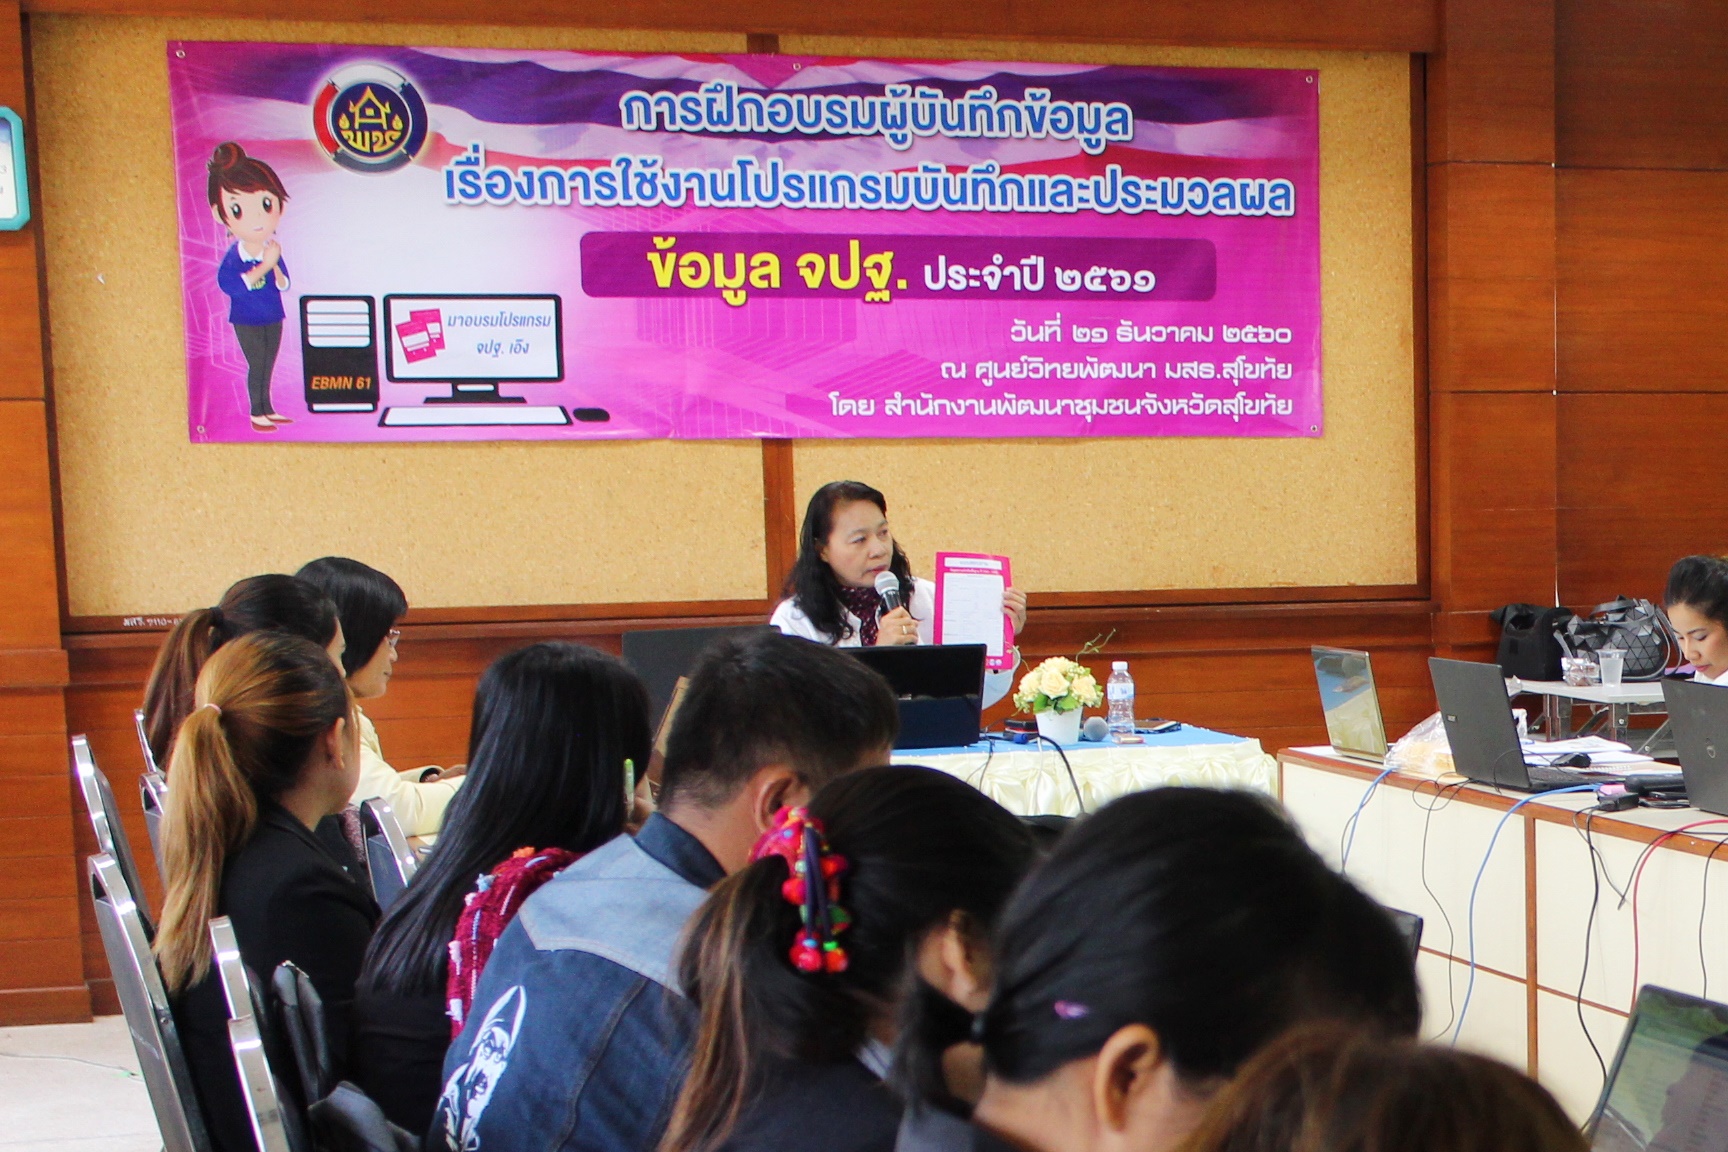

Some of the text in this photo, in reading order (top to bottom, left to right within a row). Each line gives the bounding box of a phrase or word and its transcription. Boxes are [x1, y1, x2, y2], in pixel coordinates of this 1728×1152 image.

[621, 80, 1131, 151] การฝึกอบรมผู้บันทึกข้อมูล
[444, 142, 1292, 212] เรื่องการใช้งานโปรแกรมบันทึกและประมวลผล
[647, 236, 1156, 306] ข้อมูล จปฐ. ประจำปี ๒๕๖๑
[1010, 312, 1292, 344] วันที่ ๒๑ ธันวาคม ๒๕๖๐
[311, 375, 371, 390] EBMN 61
[941, 361, 967, 379] ณ
[975, 355, 1156, 387] ศูนย์วิทยพัฒนา
[828, 391, 1293, 423] โดย สำนักงานพัฒนาชุมชนจังหวัดสุโขทัย
